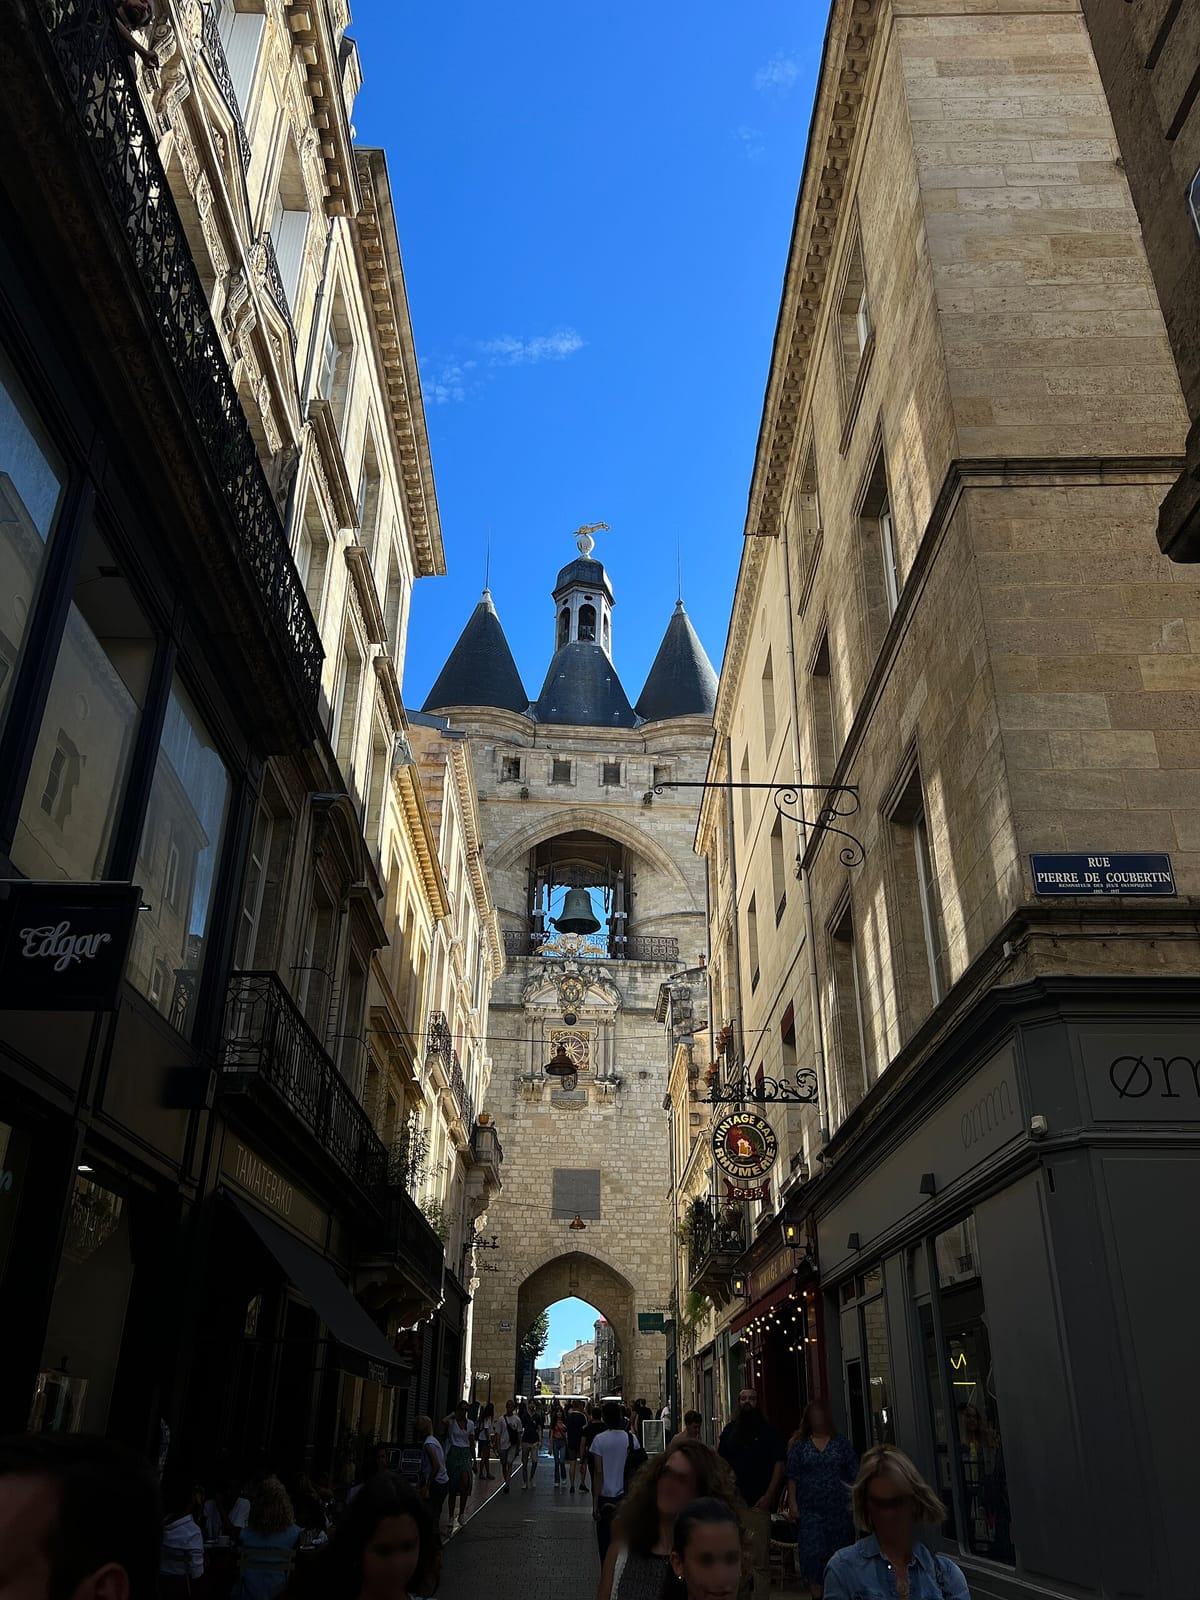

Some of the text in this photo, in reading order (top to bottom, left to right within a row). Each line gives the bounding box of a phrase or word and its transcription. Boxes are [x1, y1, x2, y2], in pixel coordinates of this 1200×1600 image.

[1037, 872, 1171, 883] PIERRE DE COUBERTIN
[1087, 857, 1111, 868] RUE
[19, 920, 112, 972] Edgar
[715, 1113, 775, 1143] VINTAGE BAR
[715, 1147, 776, 1177] RHUMERIE
[235, 1144, 293, 1215] TAMATEBAKO
